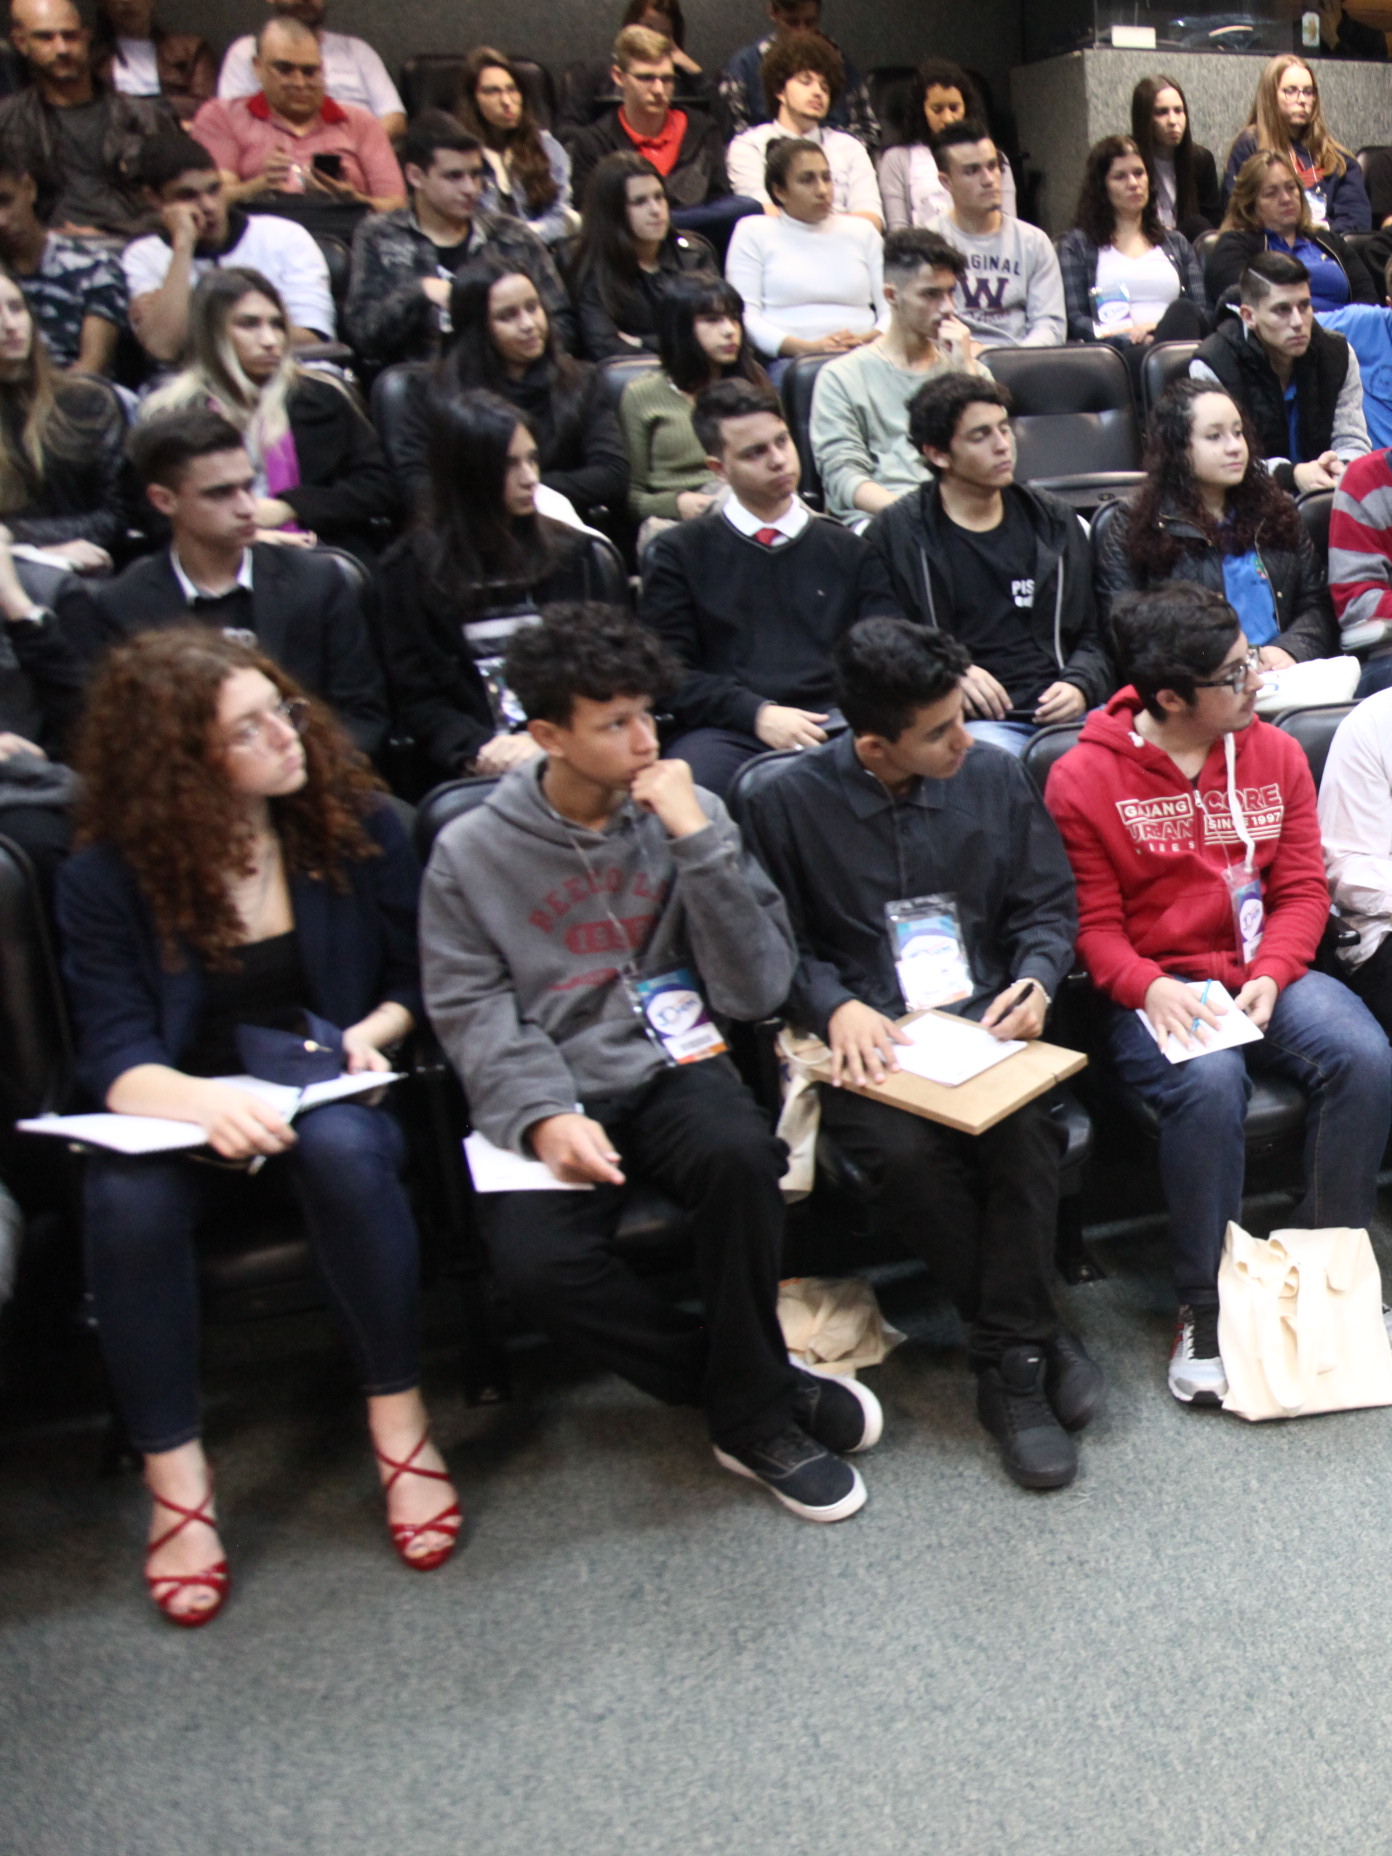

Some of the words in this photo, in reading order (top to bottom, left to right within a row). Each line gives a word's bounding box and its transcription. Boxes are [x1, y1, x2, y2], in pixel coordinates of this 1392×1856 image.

[959, 278, 1009, 309] W
[1208, 816, 1249, 830] SINE
[1250, 811, 1281, 826] 1997
